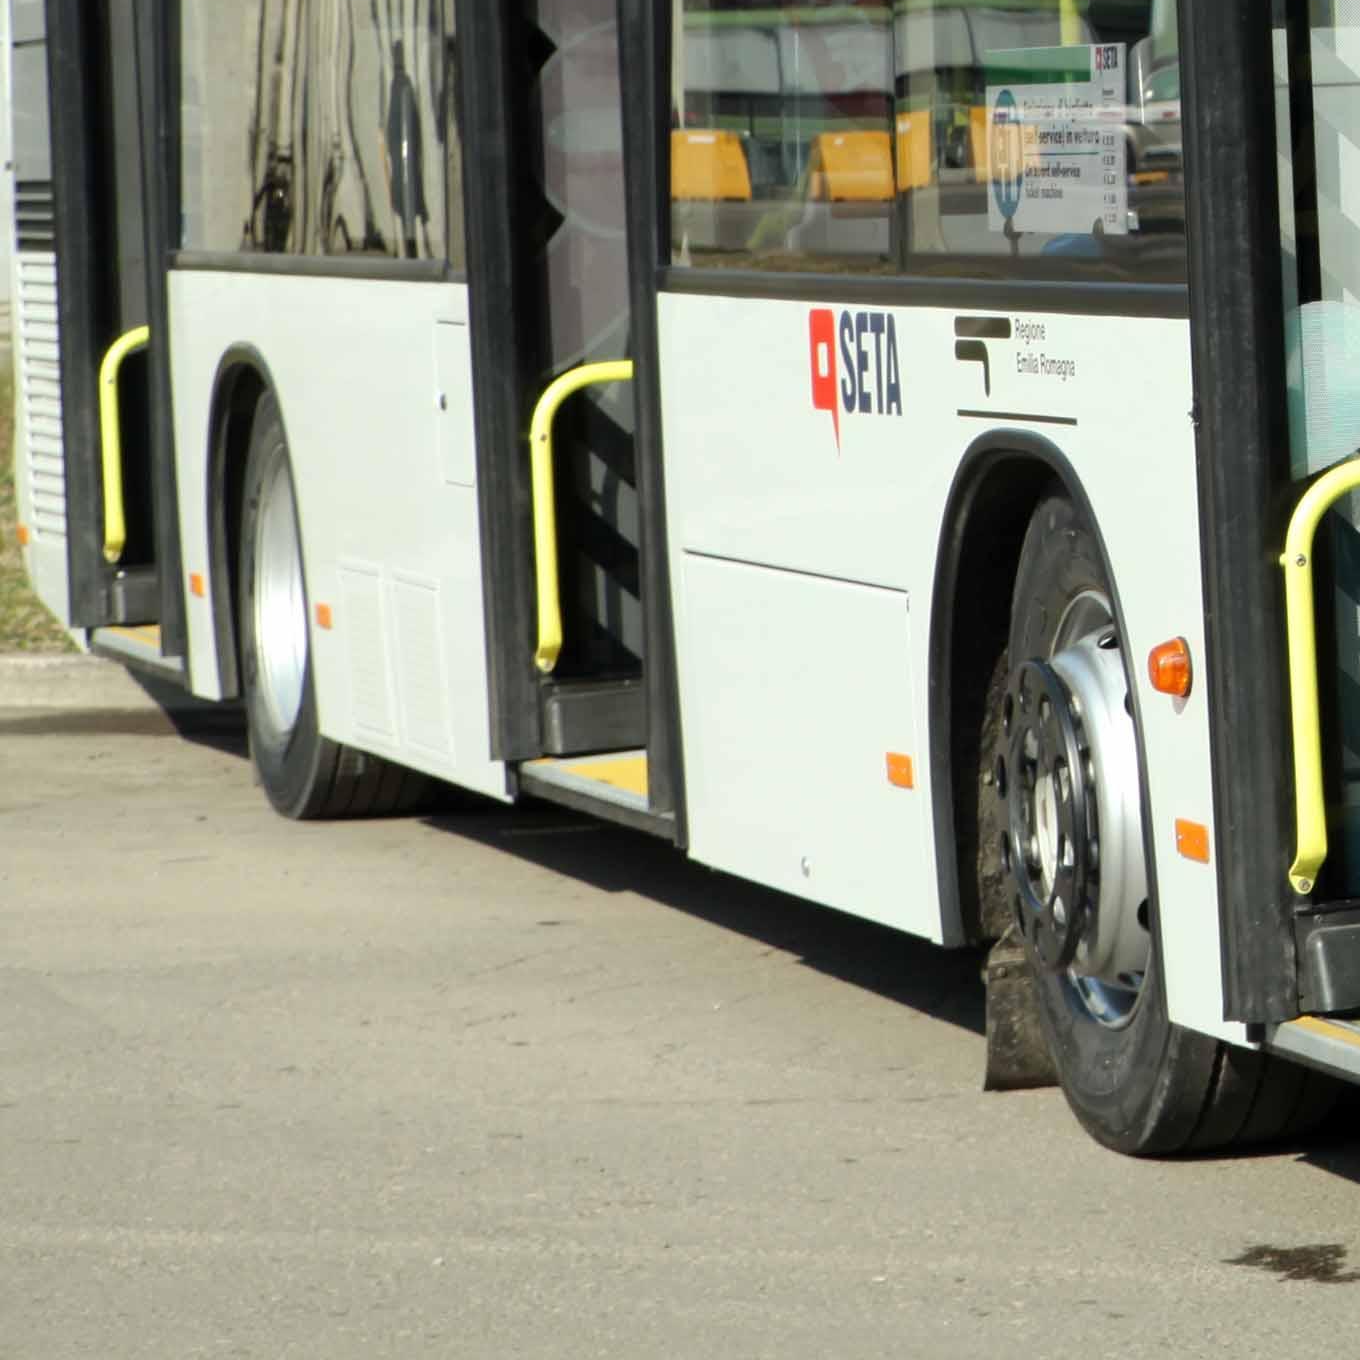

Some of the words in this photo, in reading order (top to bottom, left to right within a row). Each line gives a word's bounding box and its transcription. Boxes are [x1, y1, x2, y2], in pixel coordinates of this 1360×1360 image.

[1103, 46, 1118, 70] SETA
[1015, 318, 1046, 345] Regione
[839, 310, 903, 417] SETA
[1016, 351, 1039, 374] Emilia
[1040, 353, 1075, 382] Romagna
